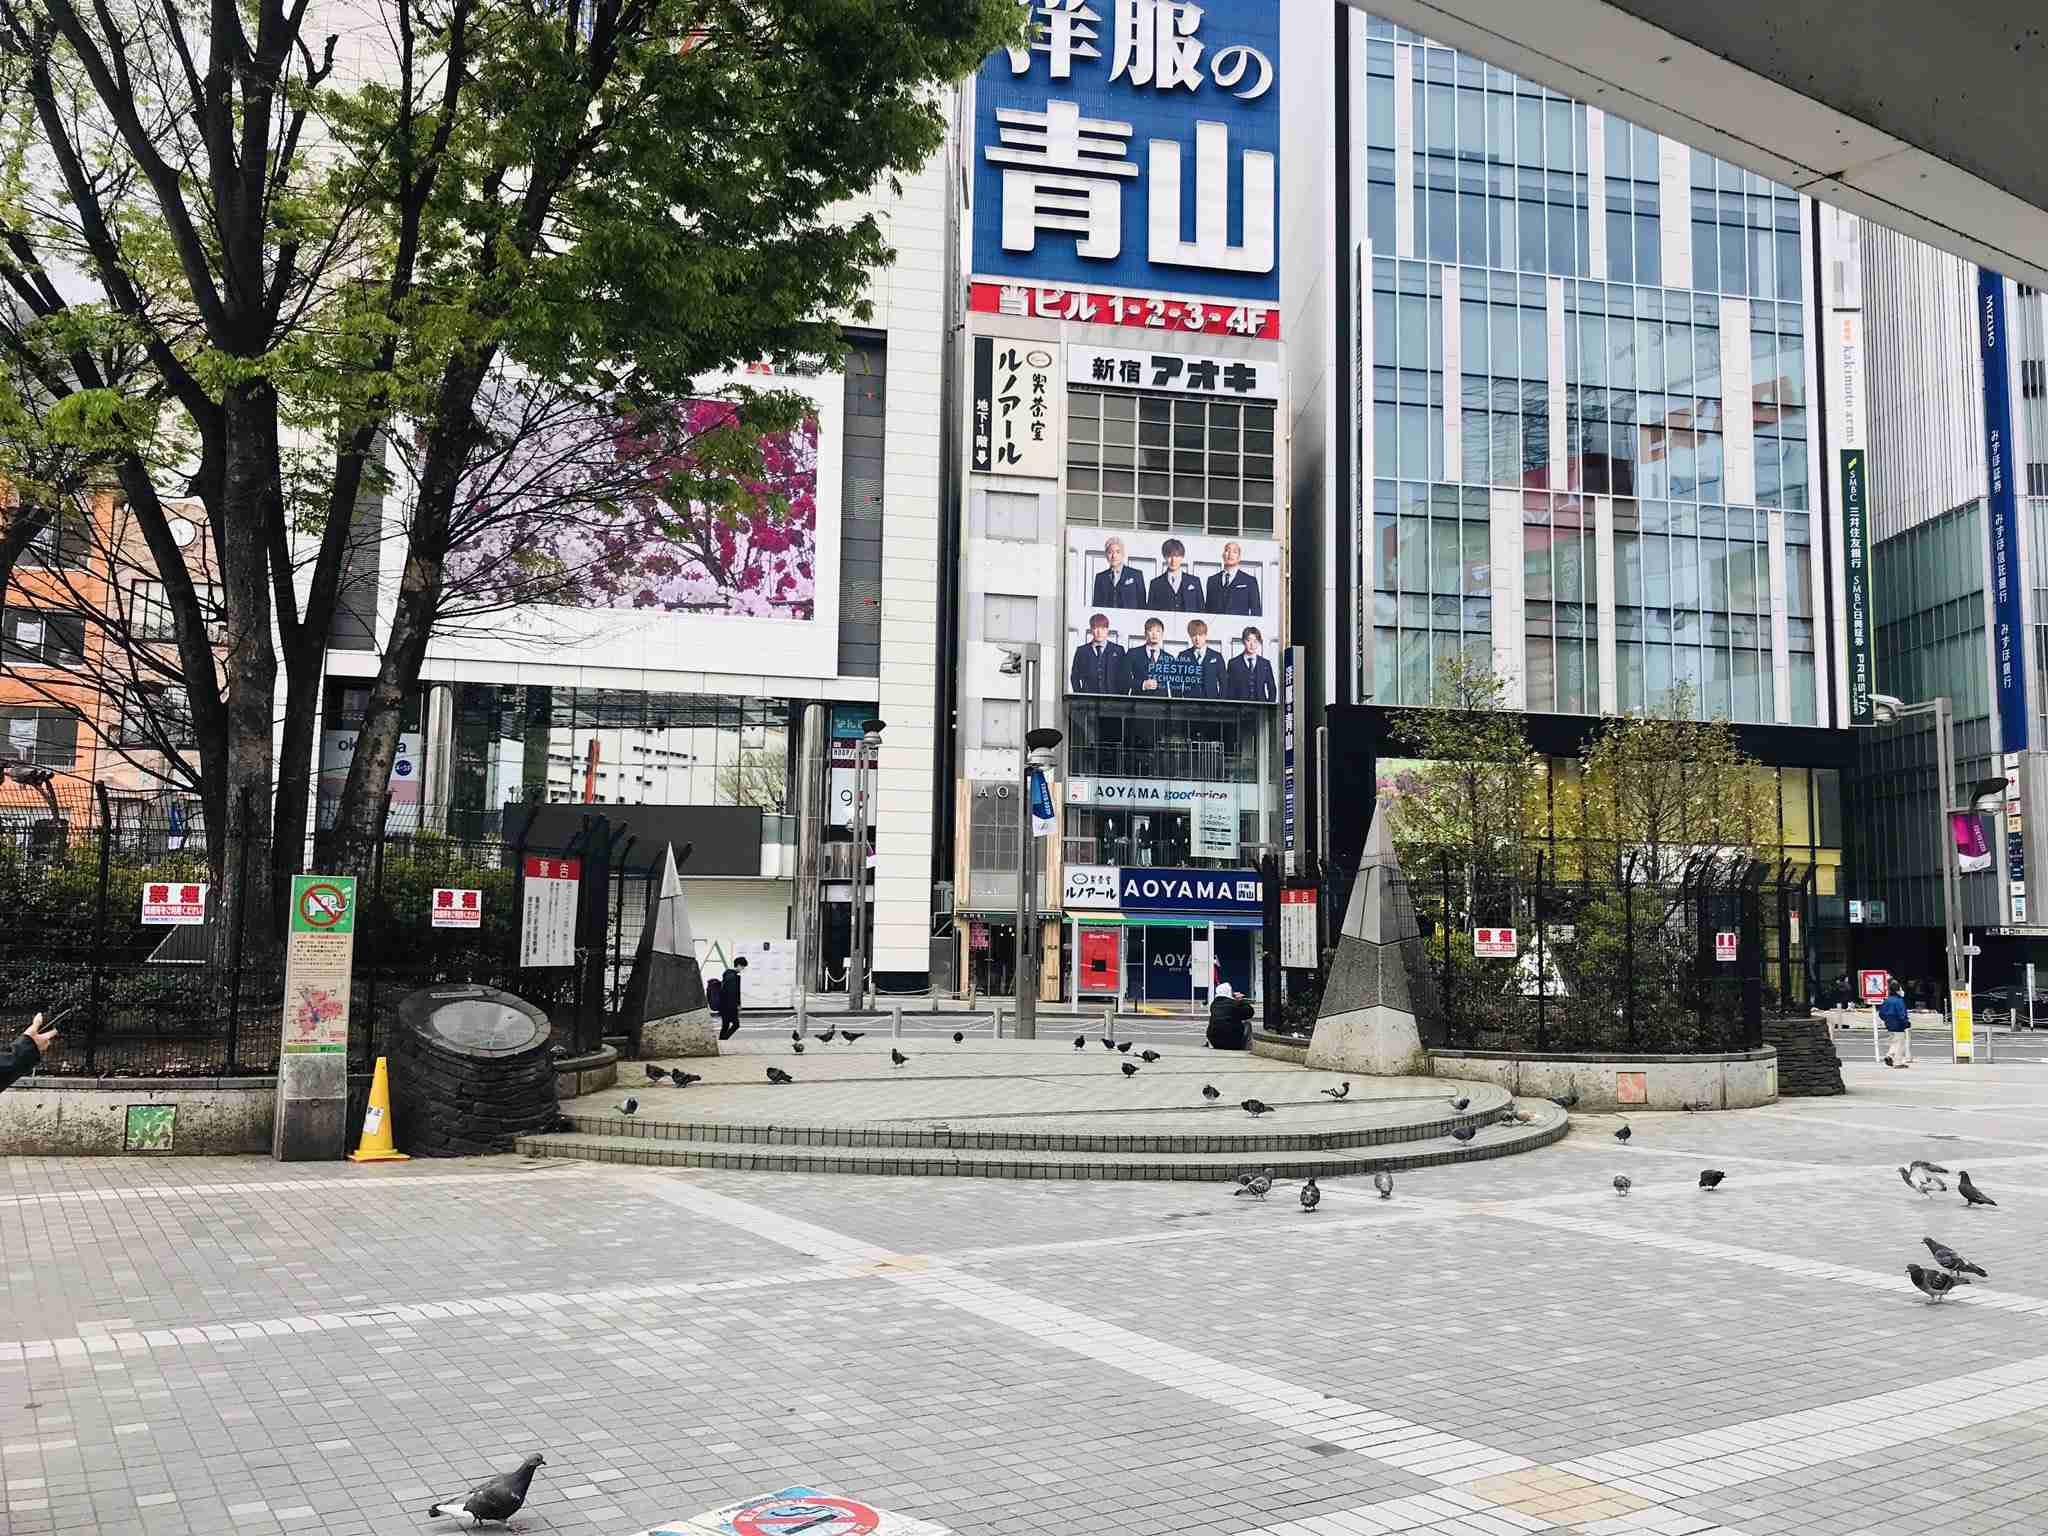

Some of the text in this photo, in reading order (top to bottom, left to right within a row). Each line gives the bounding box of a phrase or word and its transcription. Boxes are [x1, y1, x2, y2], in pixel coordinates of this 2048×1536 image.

[985, 99, 1275, 273] 青山
[1985, 295, 1995, 347] MIZUHO
[998, 348, 1022, 465] ルノアール
[1030, 373, 1047, 441] 喫茶室
[1148, 663, 1202, 675] PRESTIGE
[1095, 783, 1160, 800] AOYAMA
[1066, 886, 1117, 900] ルノアール
[1124, 879, 1233, 900] AOYAMA
[1153, 953, 1221, 968] AOYAA
